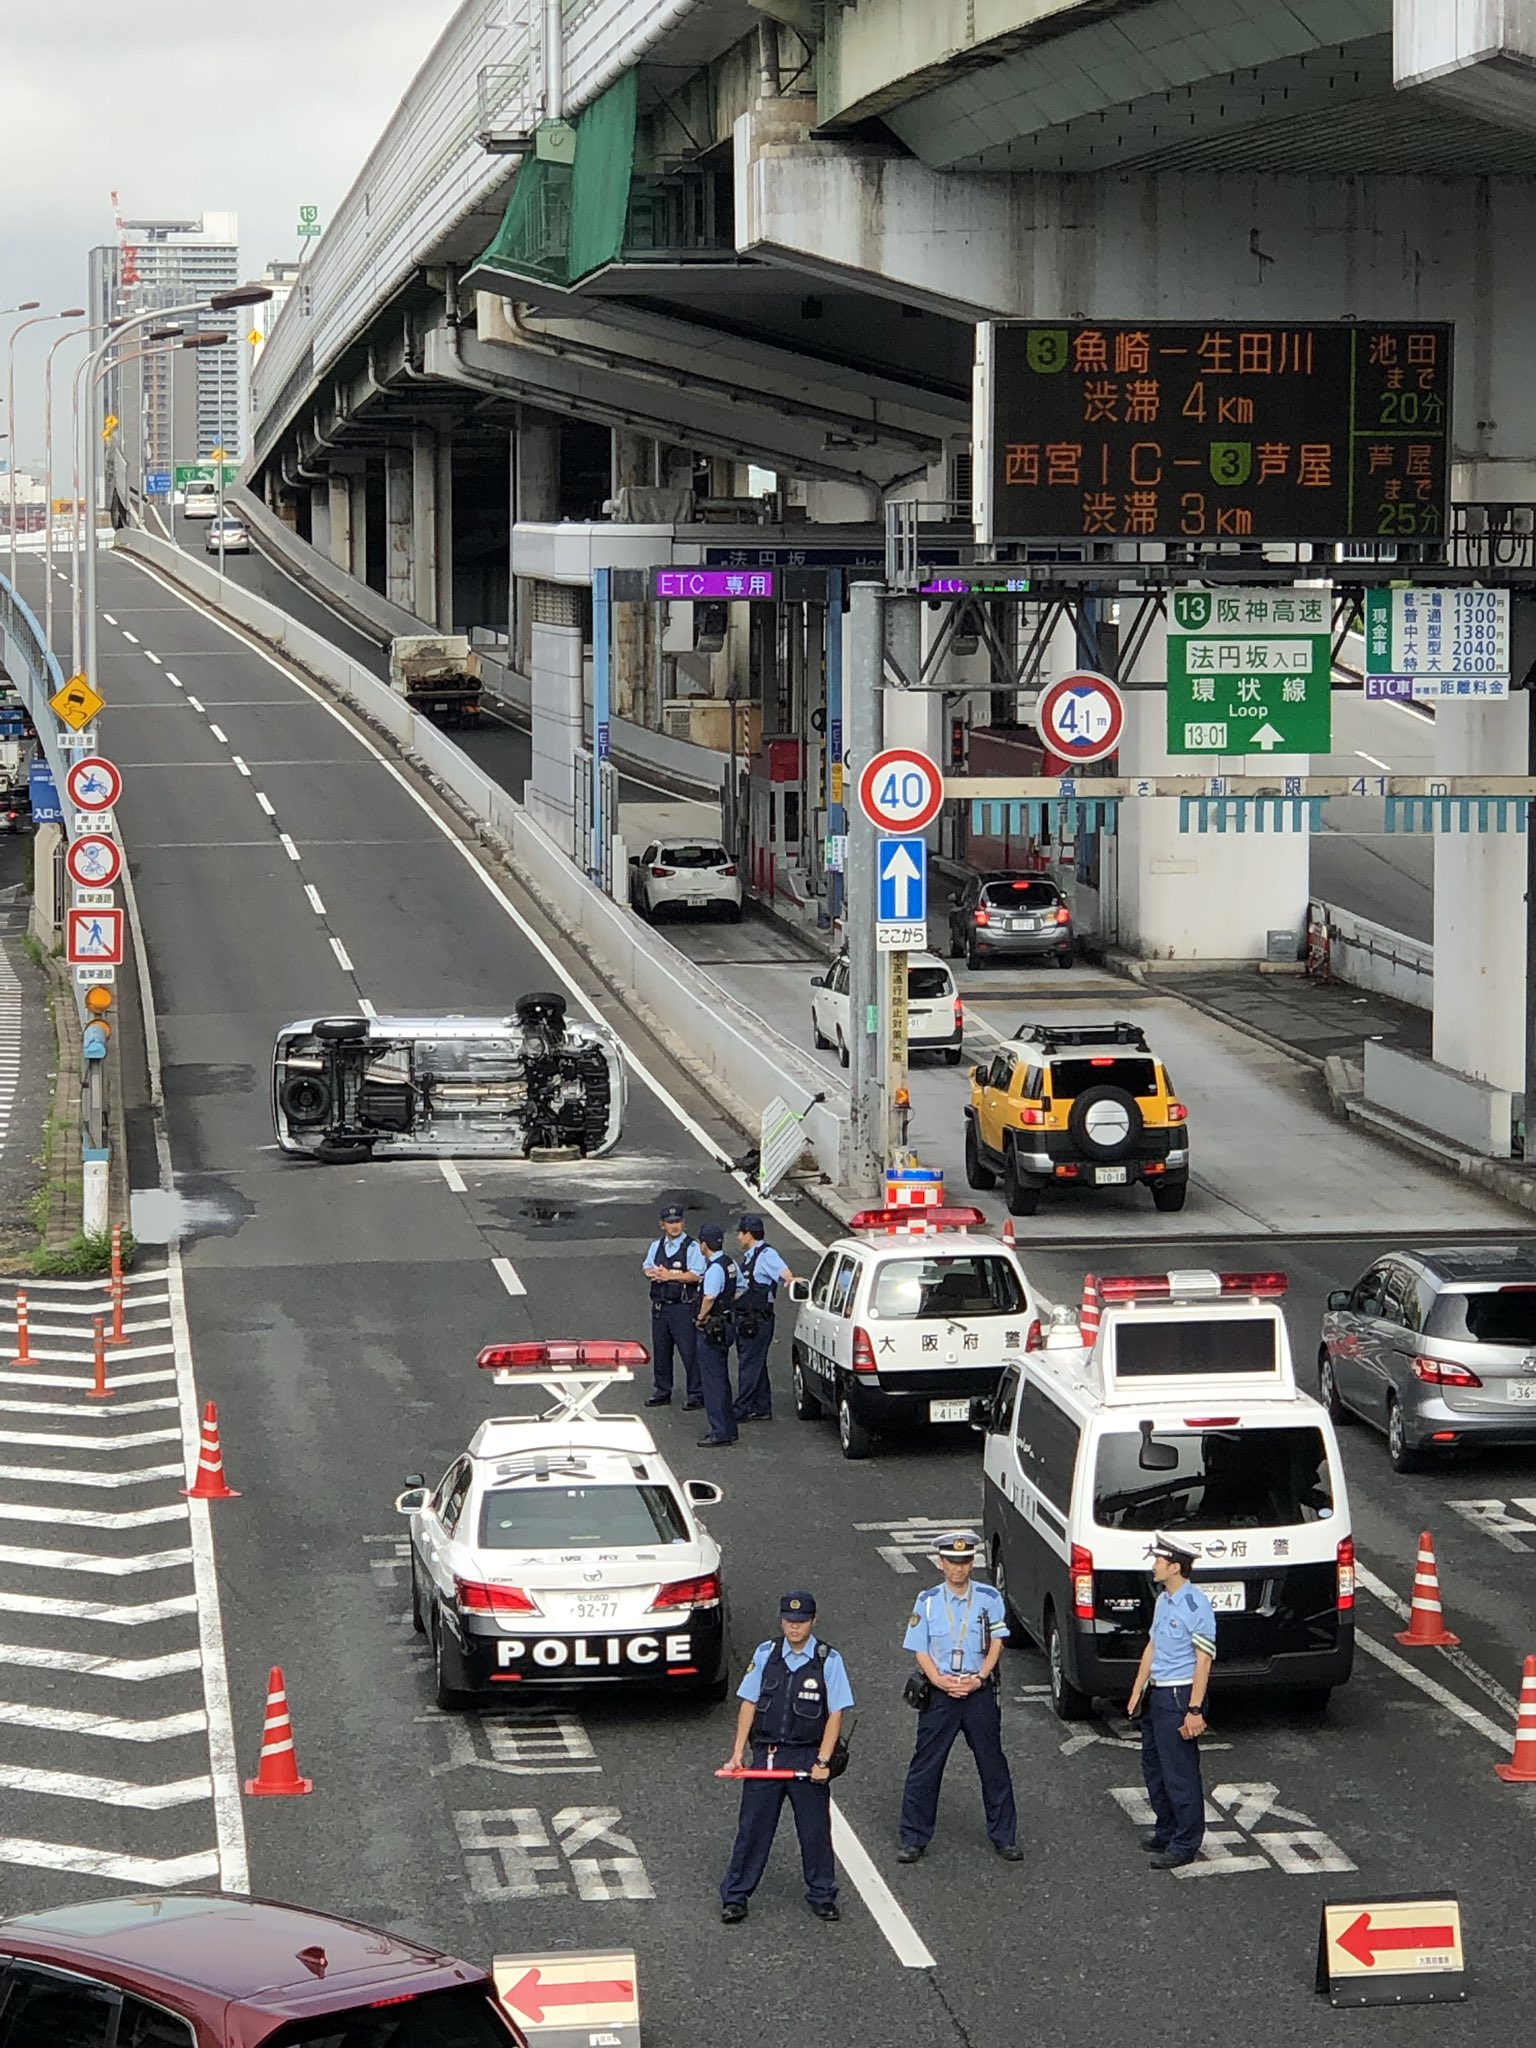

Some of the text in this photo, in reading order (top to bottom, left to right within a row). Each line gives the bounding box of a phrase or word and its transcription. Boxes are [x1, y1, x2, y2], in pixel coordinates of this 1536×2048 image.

[301, 207, 316, 220] 13
[1037, 337, 1057, 366] 3
[1368, 334, 1436, 366] 池田
[1387, 368, 1435, 390] まで
[1083, 379, 1160, 424] 渋滞
[1182, 381, 1207, 424] 4
[1379, 392, 1444, 425] 20分
[1220, 449, 1241, 477] 3
[1256, 443, 1333, 487] 芦屋
[1367, 444, 1433, 475] 芦屋
[1384, 478, 1432, 500] まで
[1081, 491, 1159, 535] 渋滞
[1181, 492, 1206, 535] 3
[1377, 503, 1441, 535] 25分
[661, 574, 767, 595] ETC 専用
[1177, 597, 1322, 624] 13 阪神高速
[1372, 608, 1388, 656] 現金車
[1191, 678, 1307, 703] 環状線
[1229, 704, 1269, 720] Loop
[879, 773, 924, 808] 40
[879, 927, 925, 945] ここから
[878, 1331, 1021, 1354] 大阪府警
[577, 1602, 618, 1618] 92-77
[497, 1634, 691, 1667] POLICE
